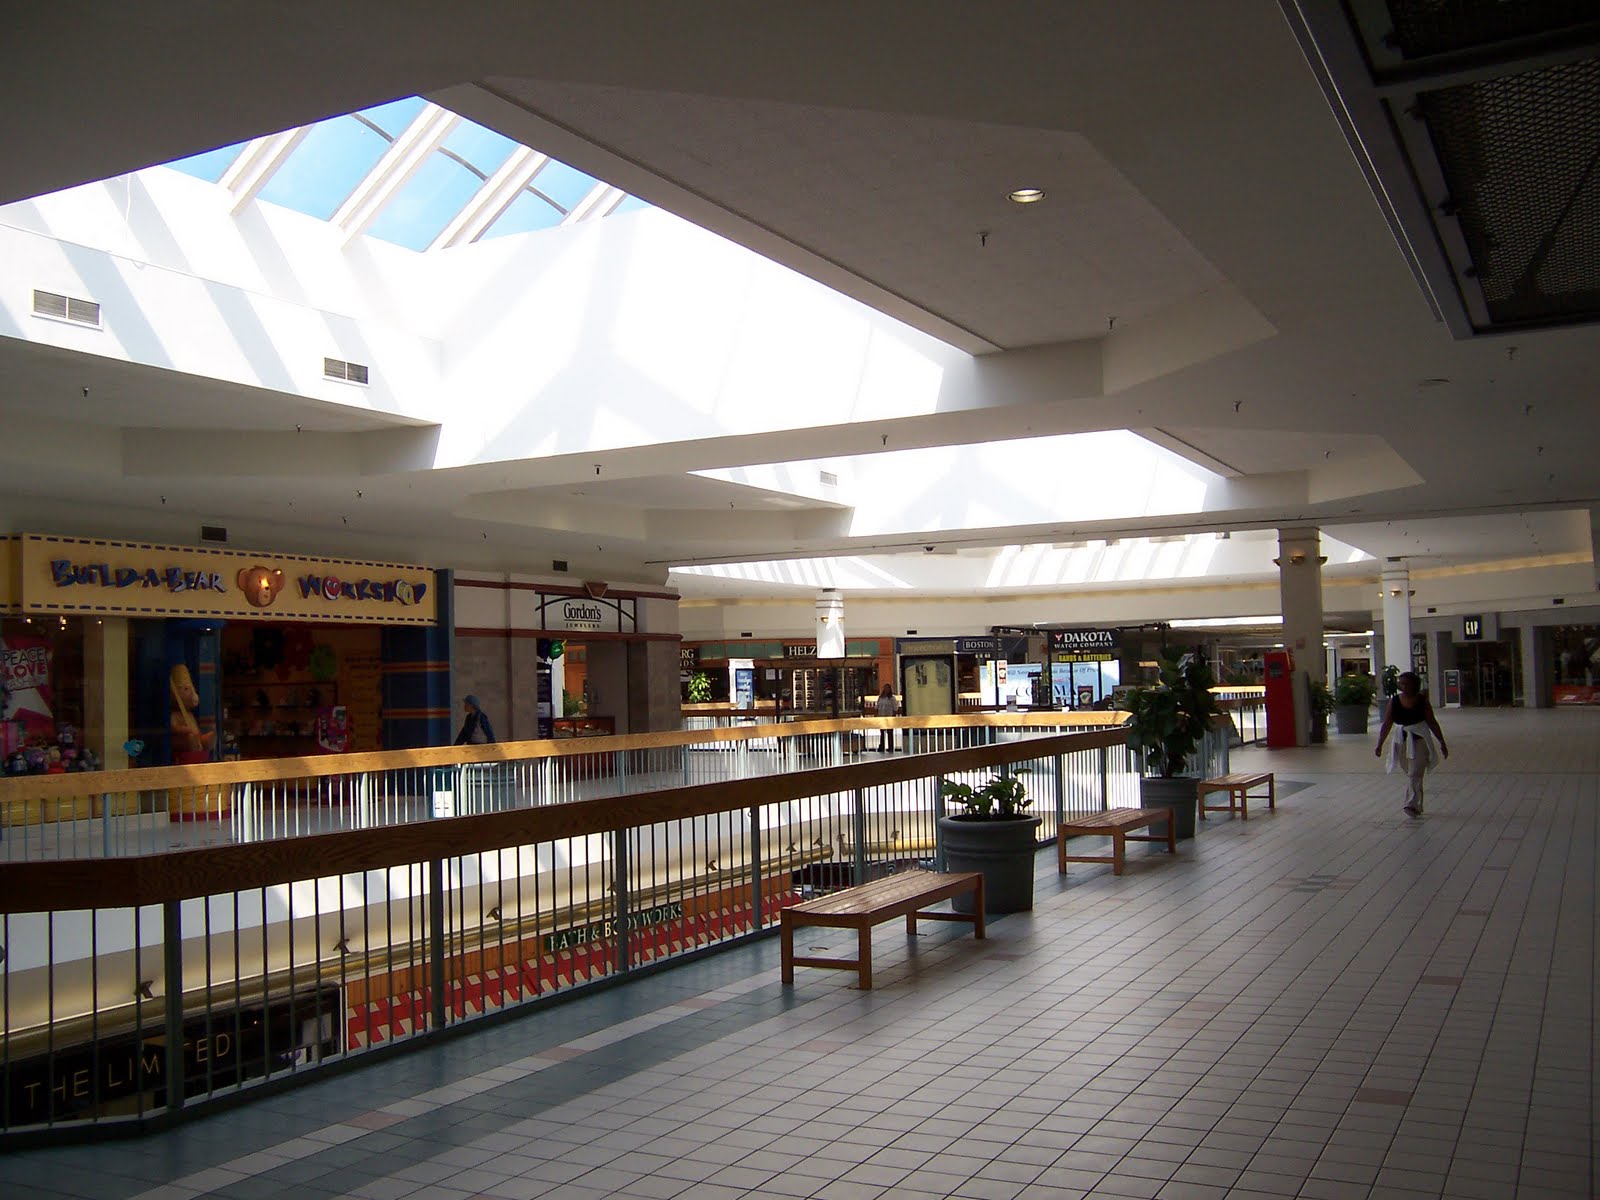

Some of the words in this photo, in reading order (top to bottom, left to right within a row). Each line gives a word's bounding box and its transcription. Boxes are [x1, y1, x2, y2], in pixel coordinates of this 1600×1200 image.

[298, 574, 427, 605] WORKSHOP
[564, 602, 601, 620] Gordon's
[1465, 620, 1479, 635] GAP
[965, 641, 994, 649] BOSTON
[1063, 631, 1113, 643] DAKOTA
[2, 649, 46, 666] PEACE
[789, 645, 817, 656] HELZ
[4, 662, 47, 680] LOVE
[591, 925, 600, 941] &
[24, 1069, 89, 1110] THE
